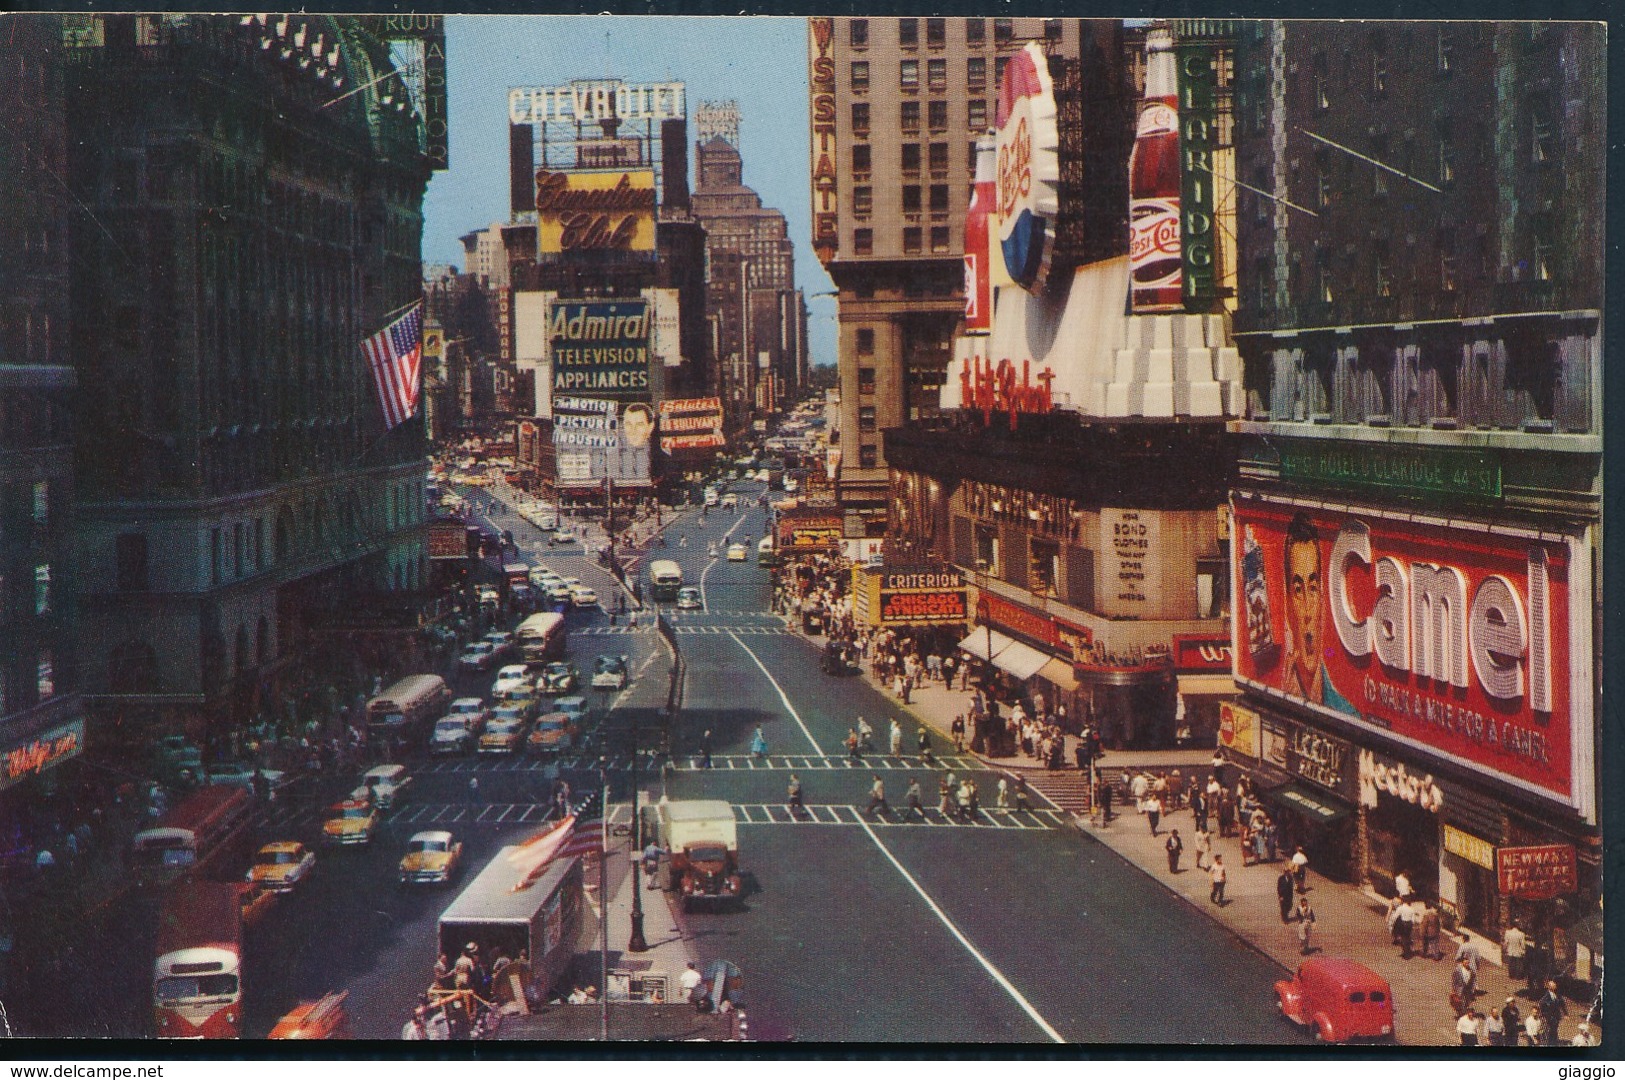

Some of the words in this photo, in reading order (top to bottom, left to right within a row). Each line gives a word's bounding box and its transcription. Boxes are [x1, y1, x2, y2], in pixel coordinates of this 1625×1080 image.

[426, 42, 448, 163] ASTOR
[509, 83, 687, 125] CHEVROLET
[813, 94, 838, 240] STATE
[1183, 55, 1212, 298] CLARIDGE
[559, 211, 639, 251] Club
[552, 303, 652, 341] Admiral
[556, 346, 647, 367] TELEVISION
[555, 369, 648, 390] APPLIANCES
[559, 415, 611, 431] PICTURE
[553, 430, 616, 448] INDUSTRY
[1113, 523, 1147, 537] BOND
[1113, 538, 1148, 549] CLOTHES
[888, 573, 960, 589] CRITERION
[883, 603, 965, 616] SYNDICATE
[890, 593, 960, 605] CHICAGO
[1329, 519, 1554, 713] Camel
[1379, 680, 1410, 716] WALK
[1414, 693, 1425, 716] A
[1426, 696, 1454, 728] MILE
[1456, 706, 1485, 744] FOR
[1487, 716, 1499, 743] A
[1502, 720, 1550, 766] CAMEL
